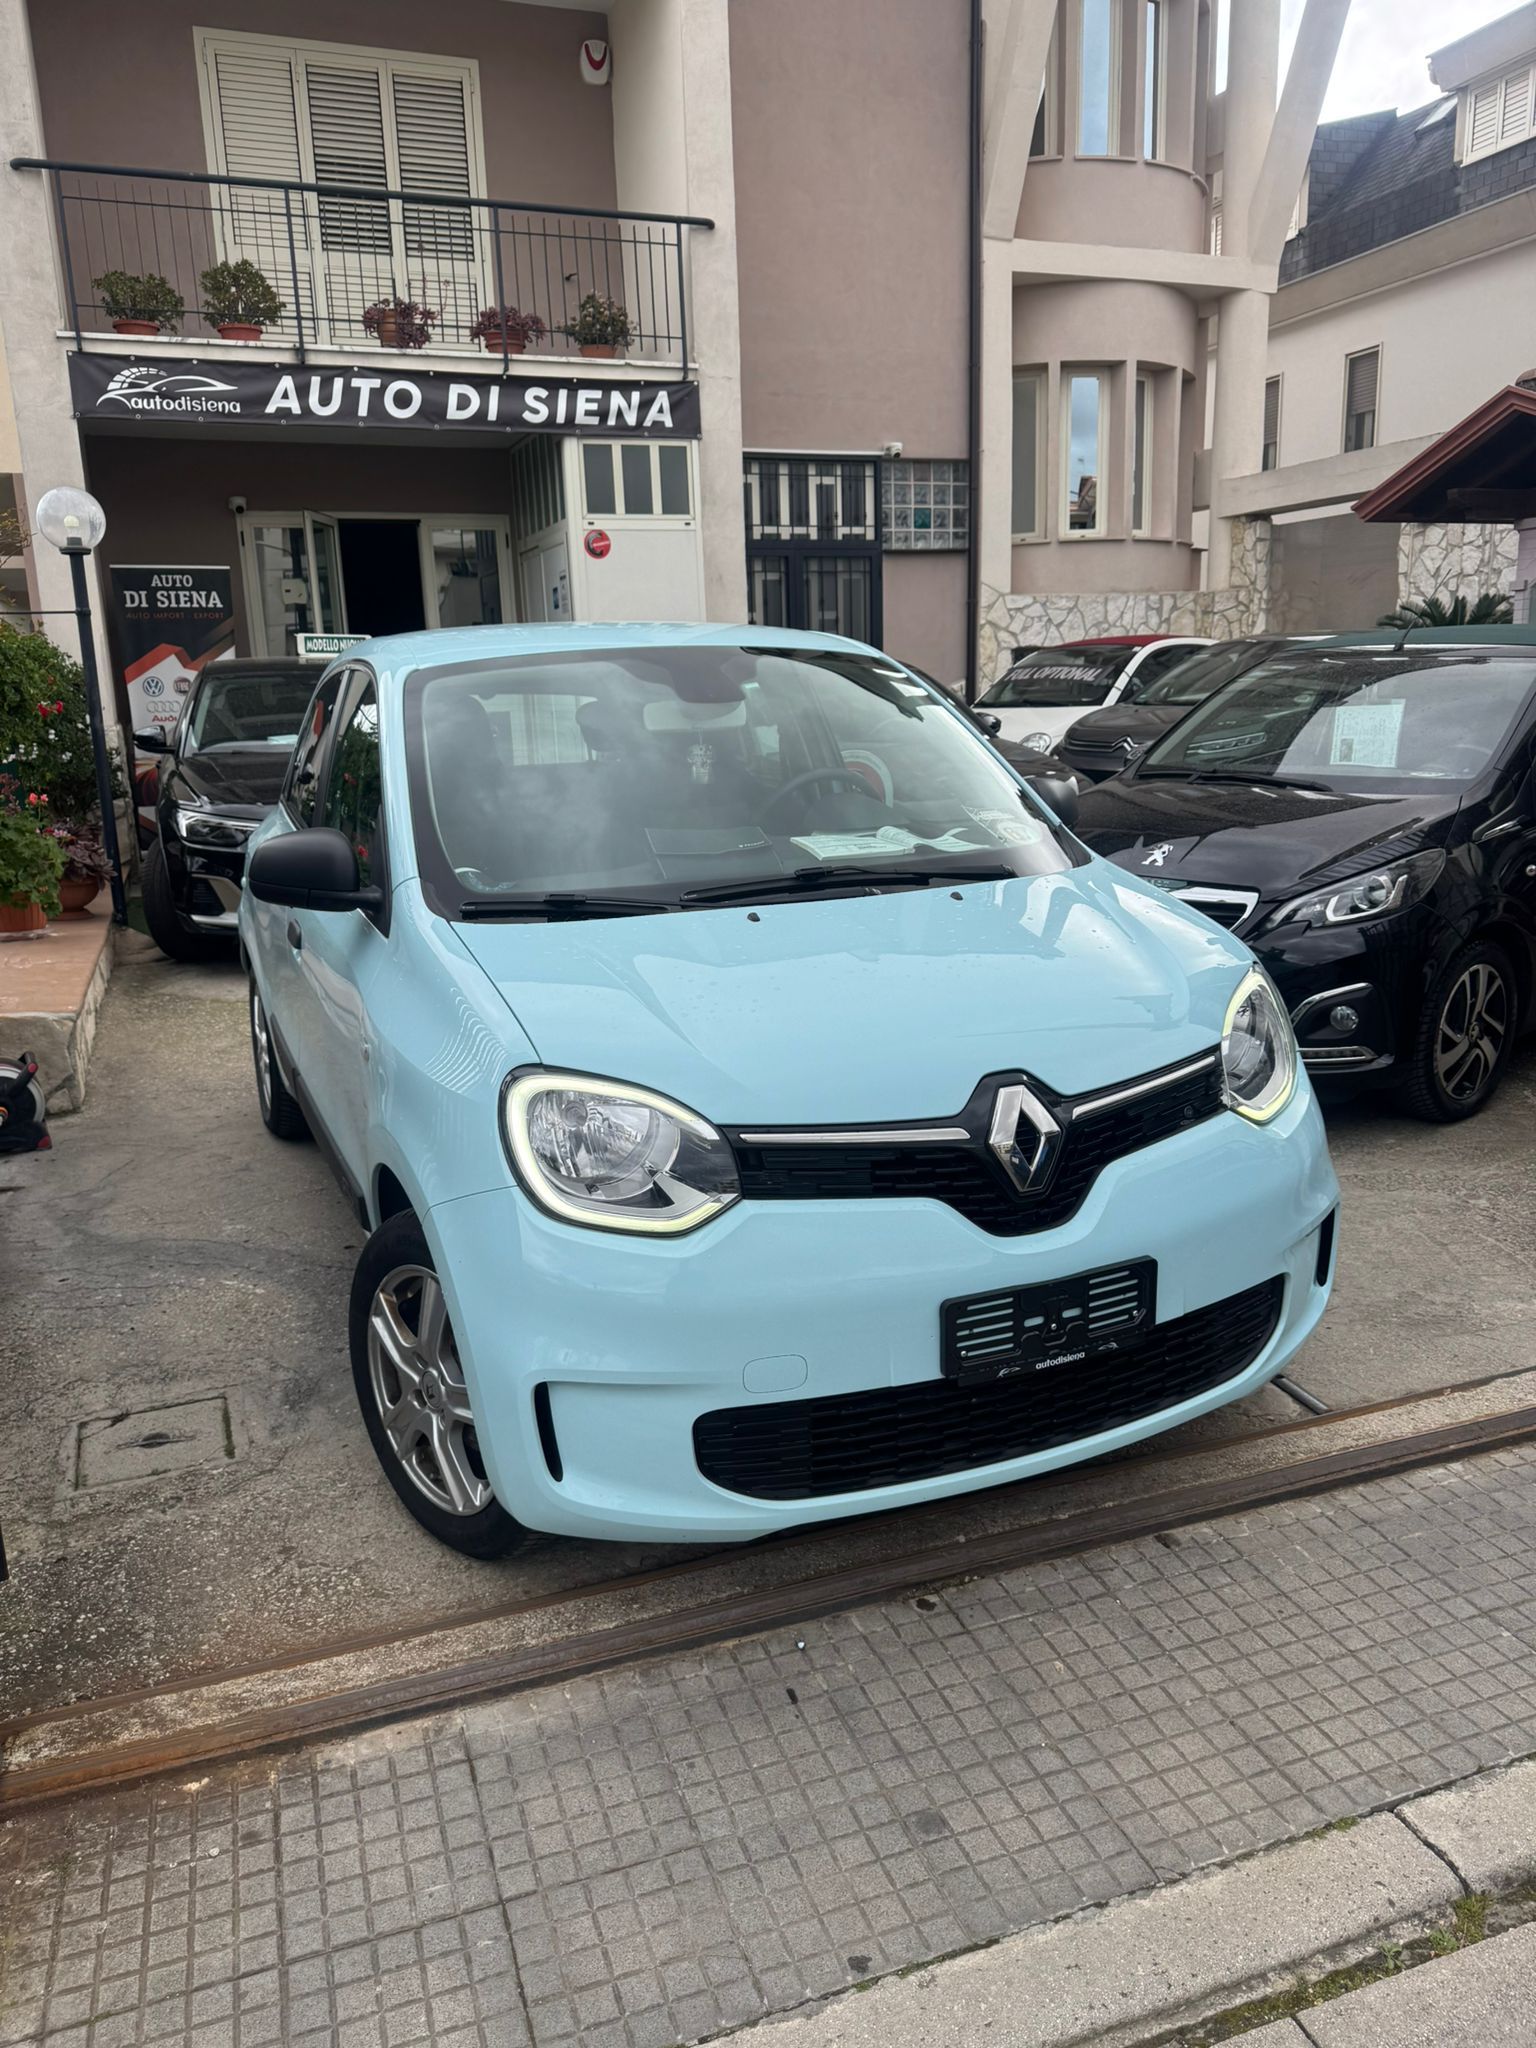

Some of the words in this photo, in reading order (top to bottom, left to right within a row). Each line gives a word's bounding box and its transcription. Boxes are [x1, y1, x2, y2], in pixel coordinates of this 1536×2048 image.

[130, 396, 241, 414] autodisiena
[264, 374, 423, 420] AUTO
[445, 382, 501, 422] DI
[521, 385, 674, 428] SIENA
[151, 574, 193, 588] AUTO
[123, 590, 149, 608] DI
[156, 590, 224, 608] SIENA
[126, 612, 151, 620] AUTO
[306, 638, 339, 651] MODELLO
[1004, 667, 1038, 681] FULL
[1034, 666, 1103, 682] OPTIONAL
[1035, 1351, 1086, 1370] autodisiena
